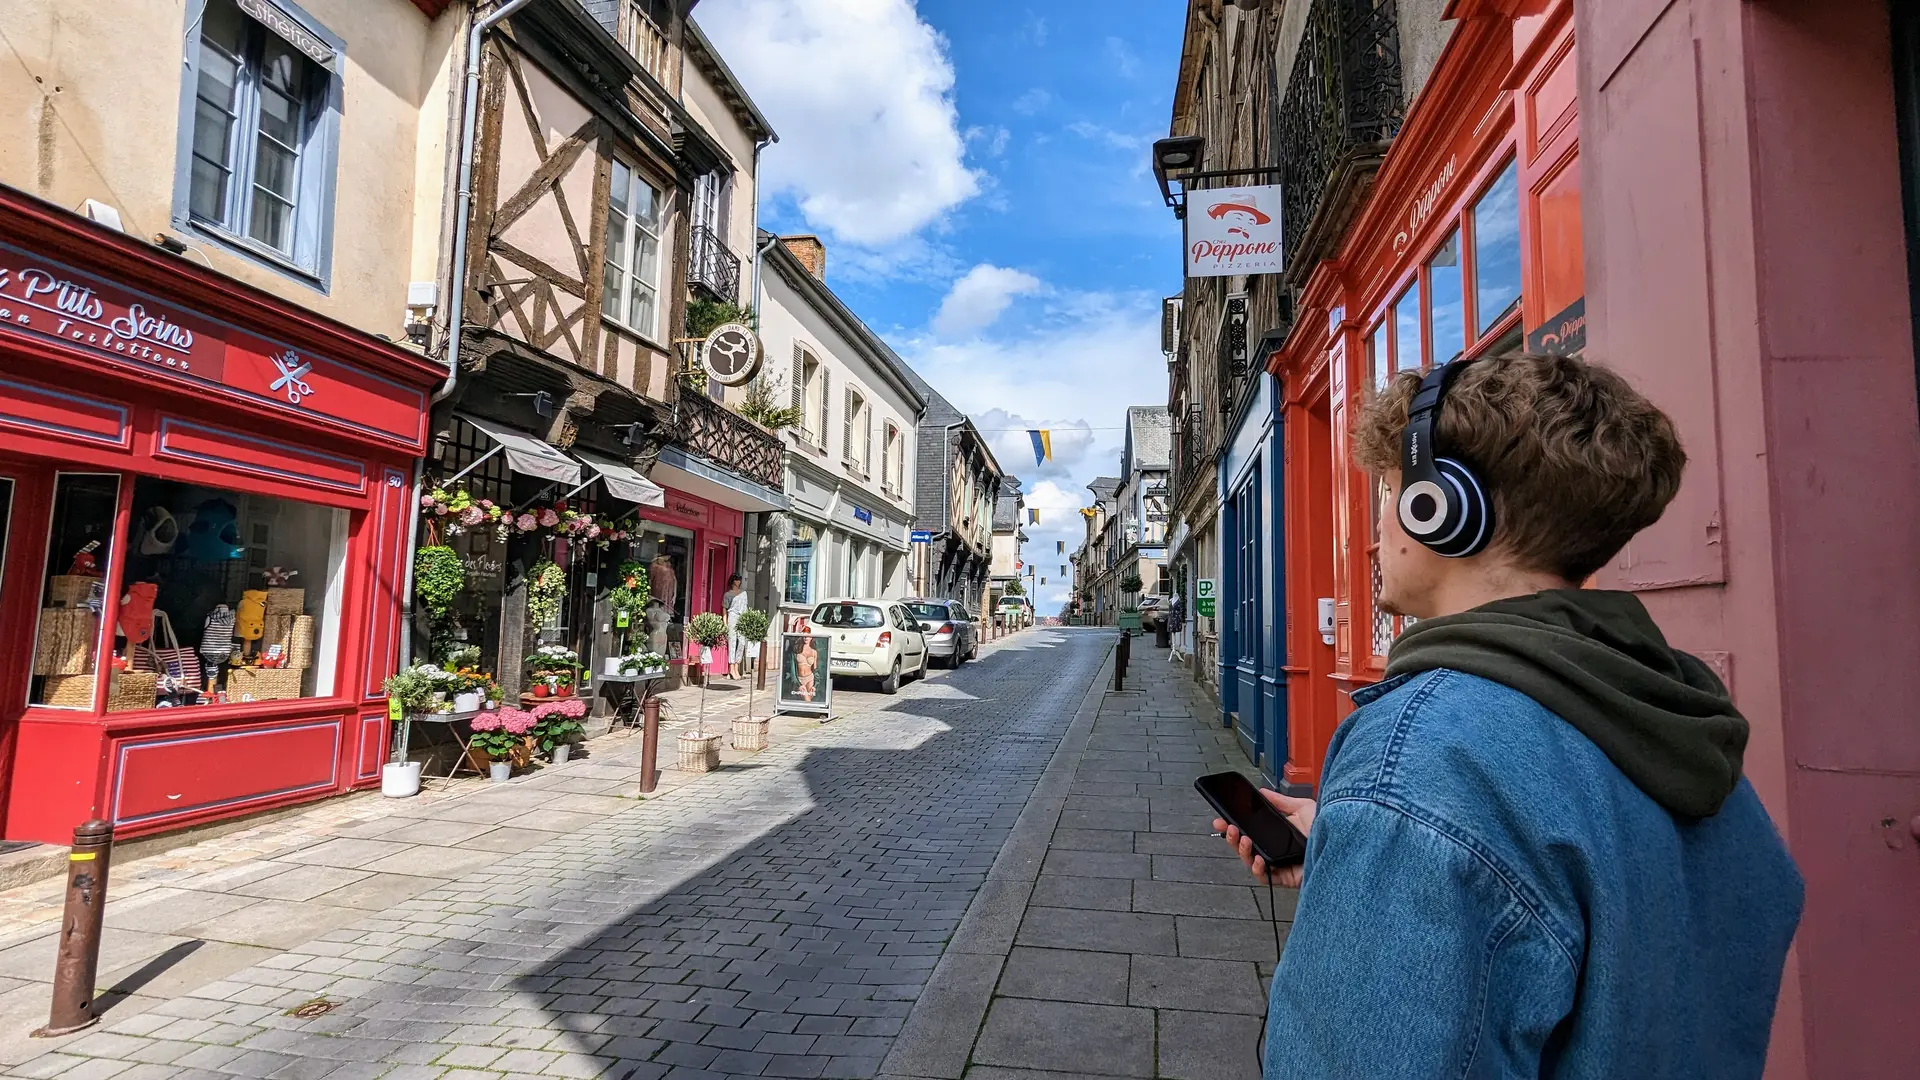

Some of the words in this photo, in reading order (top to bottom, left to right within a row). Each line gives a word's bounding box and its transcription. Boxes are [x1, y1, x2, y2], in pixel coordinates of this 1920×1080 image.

[1192, 241, 1277, 263] Peppone
[1213, 261, 1276, 269] PIZZERIA
[111, 303, 193, 348] Soins
[708, 328, 724, 343] FLEURS
[57, 318, 189, 370] Toiletteur
